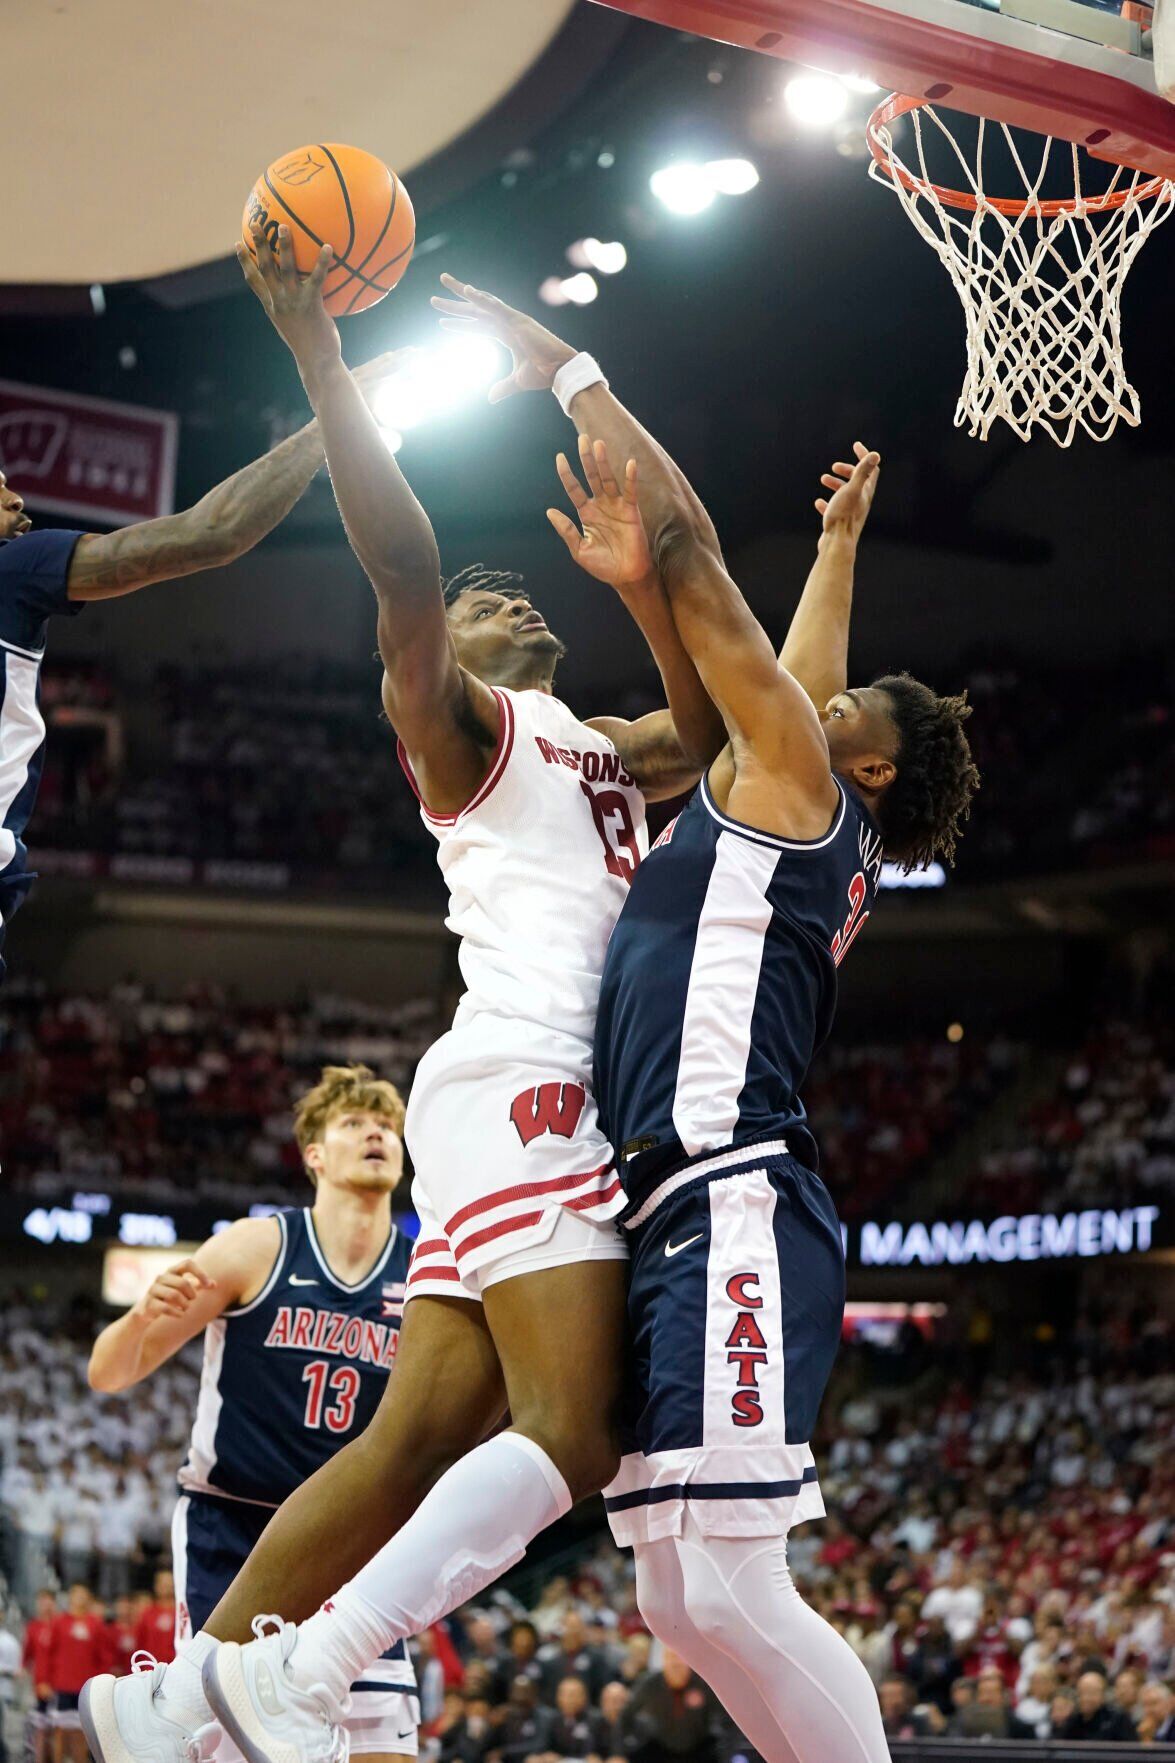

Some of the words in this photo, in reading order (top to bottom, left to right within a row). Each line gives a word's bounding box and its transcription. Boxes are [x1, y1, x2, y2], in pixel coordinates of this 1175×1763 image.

[579, 779, 641, 887] 13
[860, 1205, 1160, 1267] MANAGEMENT
[264, 1306, 400, 1370] ARIZONA
[725, 1272, 768, 1428] CATS
[301, 1359, 361, 1433] 13
